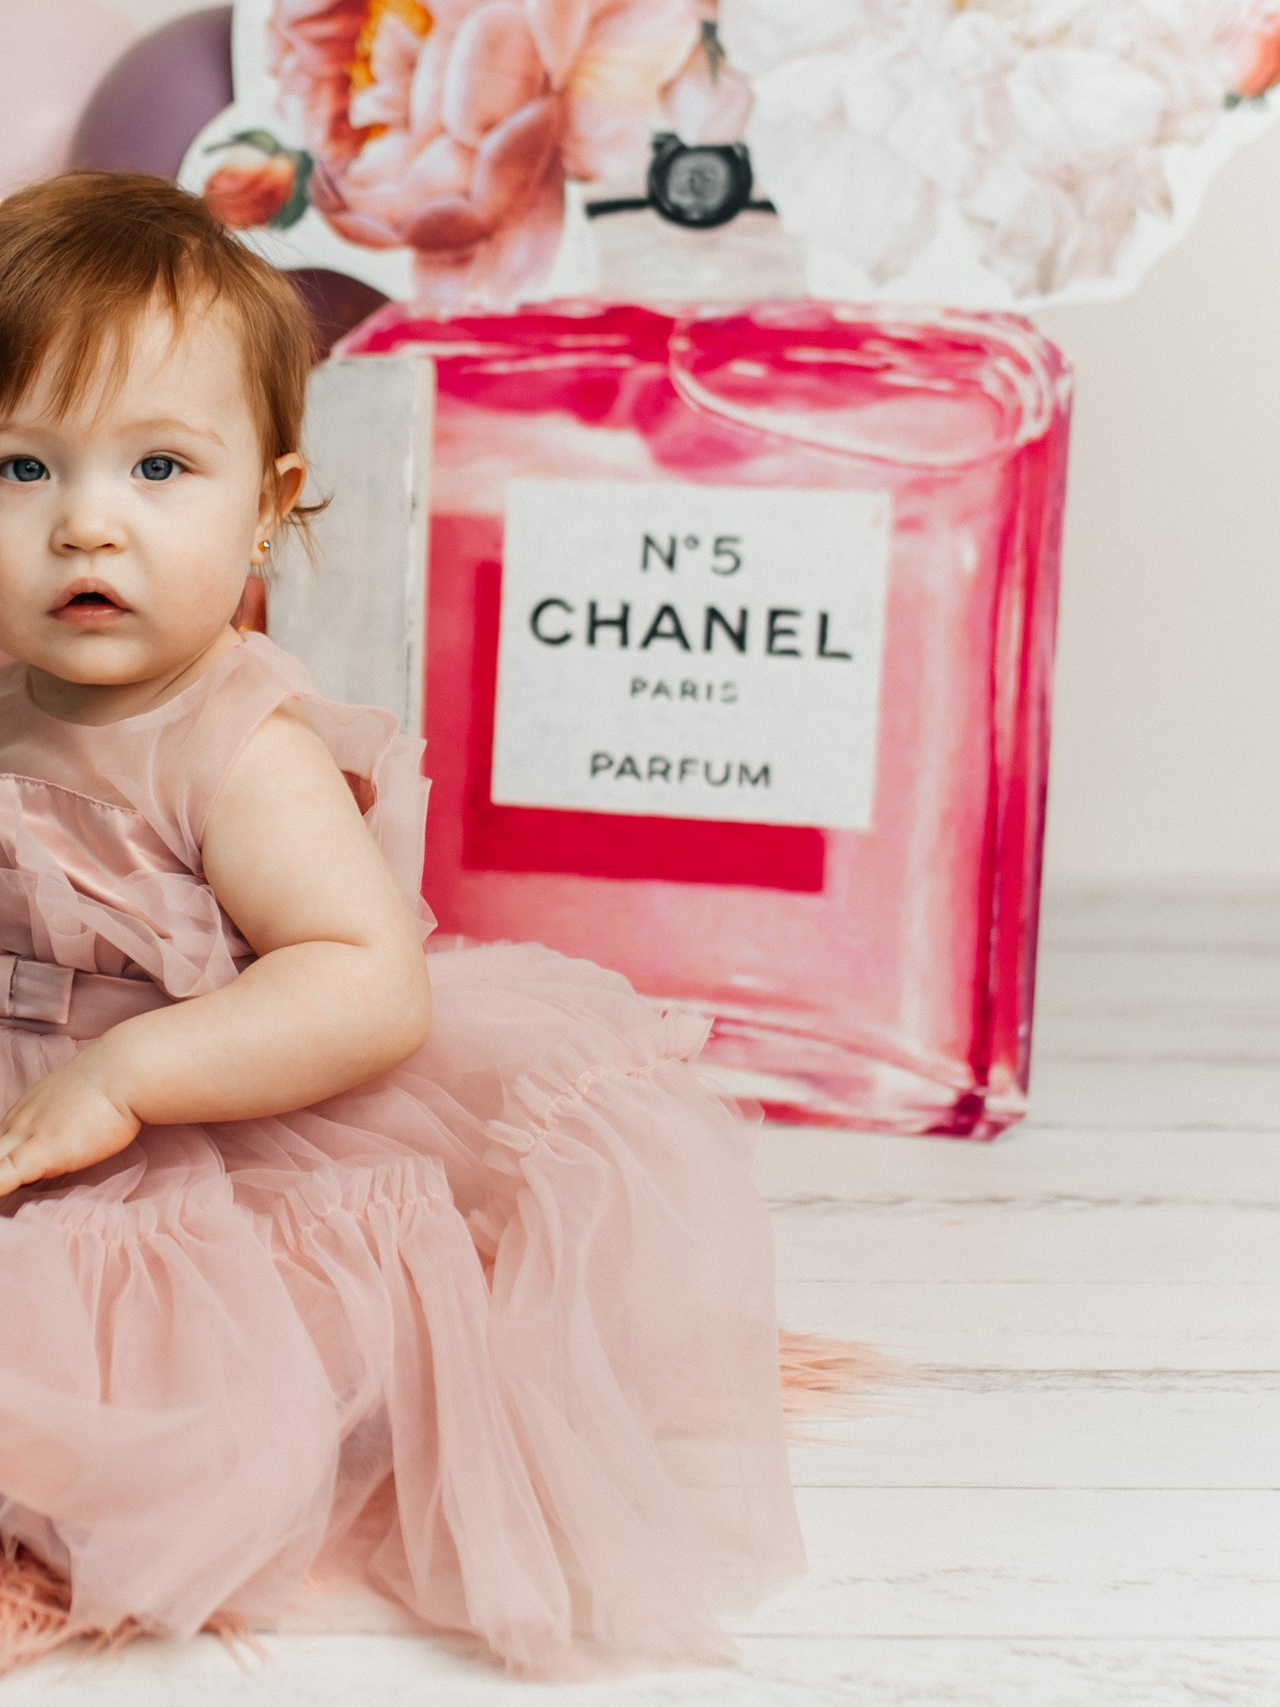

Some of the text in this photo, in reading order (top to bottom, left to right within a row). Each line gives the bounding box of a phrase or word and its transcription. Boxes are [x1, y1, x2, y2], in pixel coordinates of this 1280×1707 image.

[527, 596, 853, 661] CHANEL
[629, 675, 738, 704] PARIS
[589, 751, 772, 789] PARFUM
